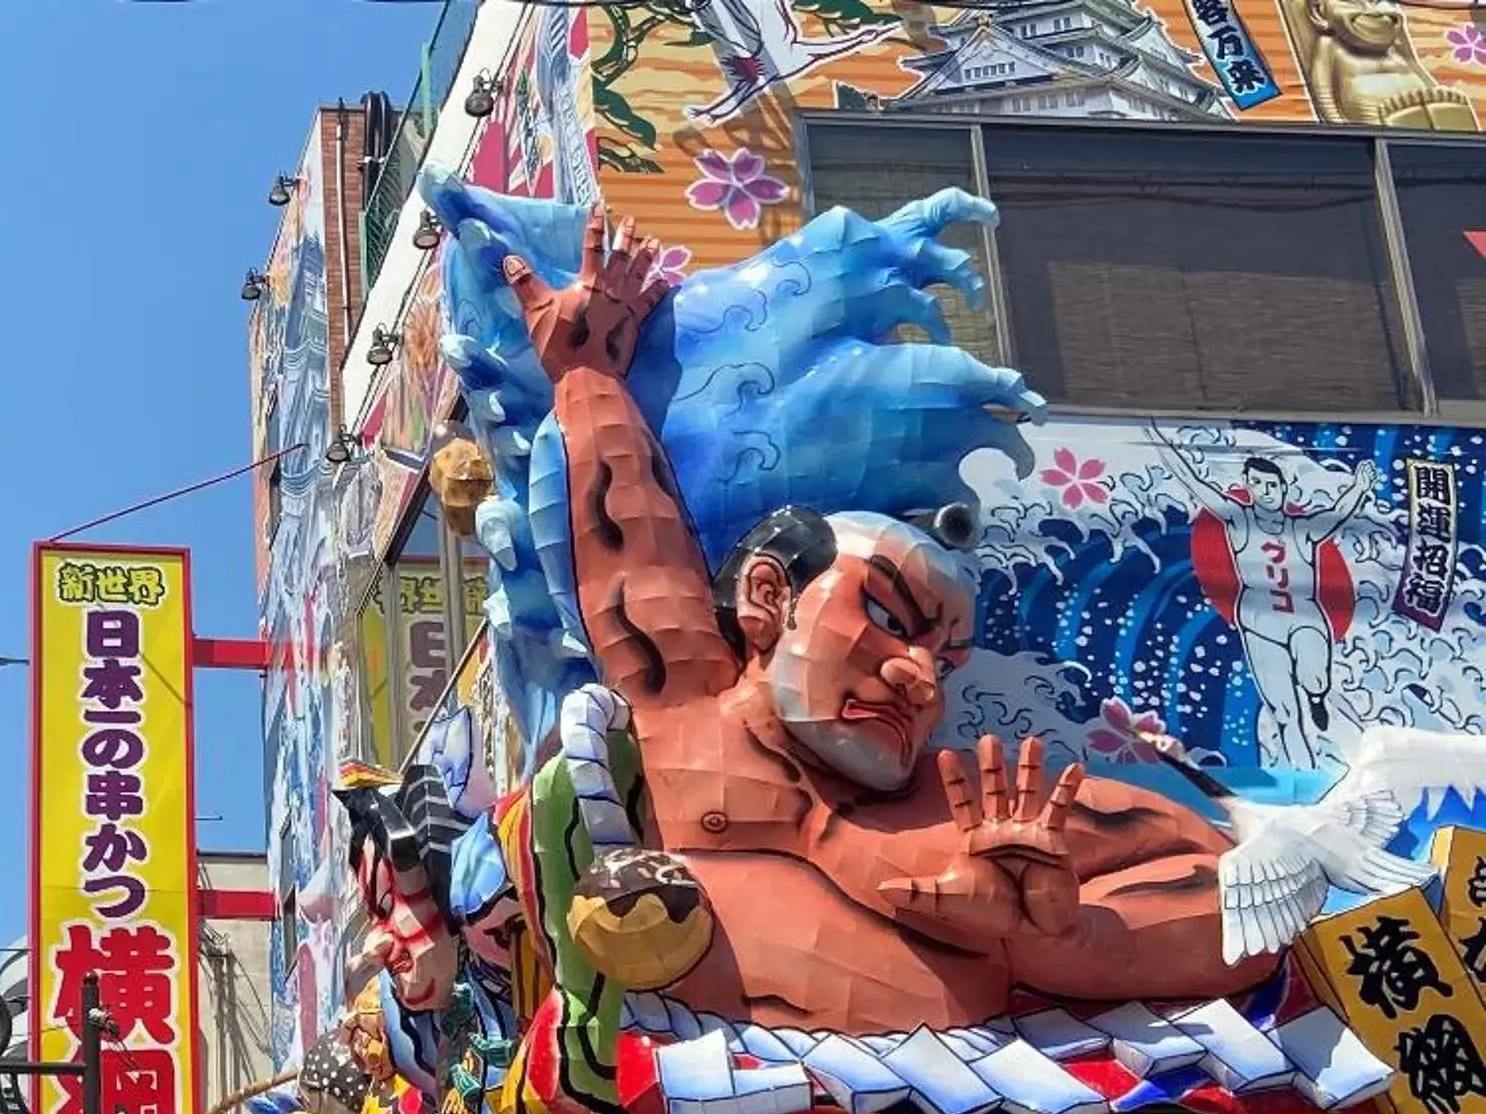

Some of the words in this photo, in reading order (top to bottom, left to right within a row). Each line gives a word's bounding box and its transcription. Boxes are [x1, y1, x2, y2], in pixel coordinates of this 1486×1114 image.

[57, 563, 165, 604] 新世界
[1406, 464, 1452, 613] 開運招福
[80, 610, 148, 920] 日本一の串かつ
